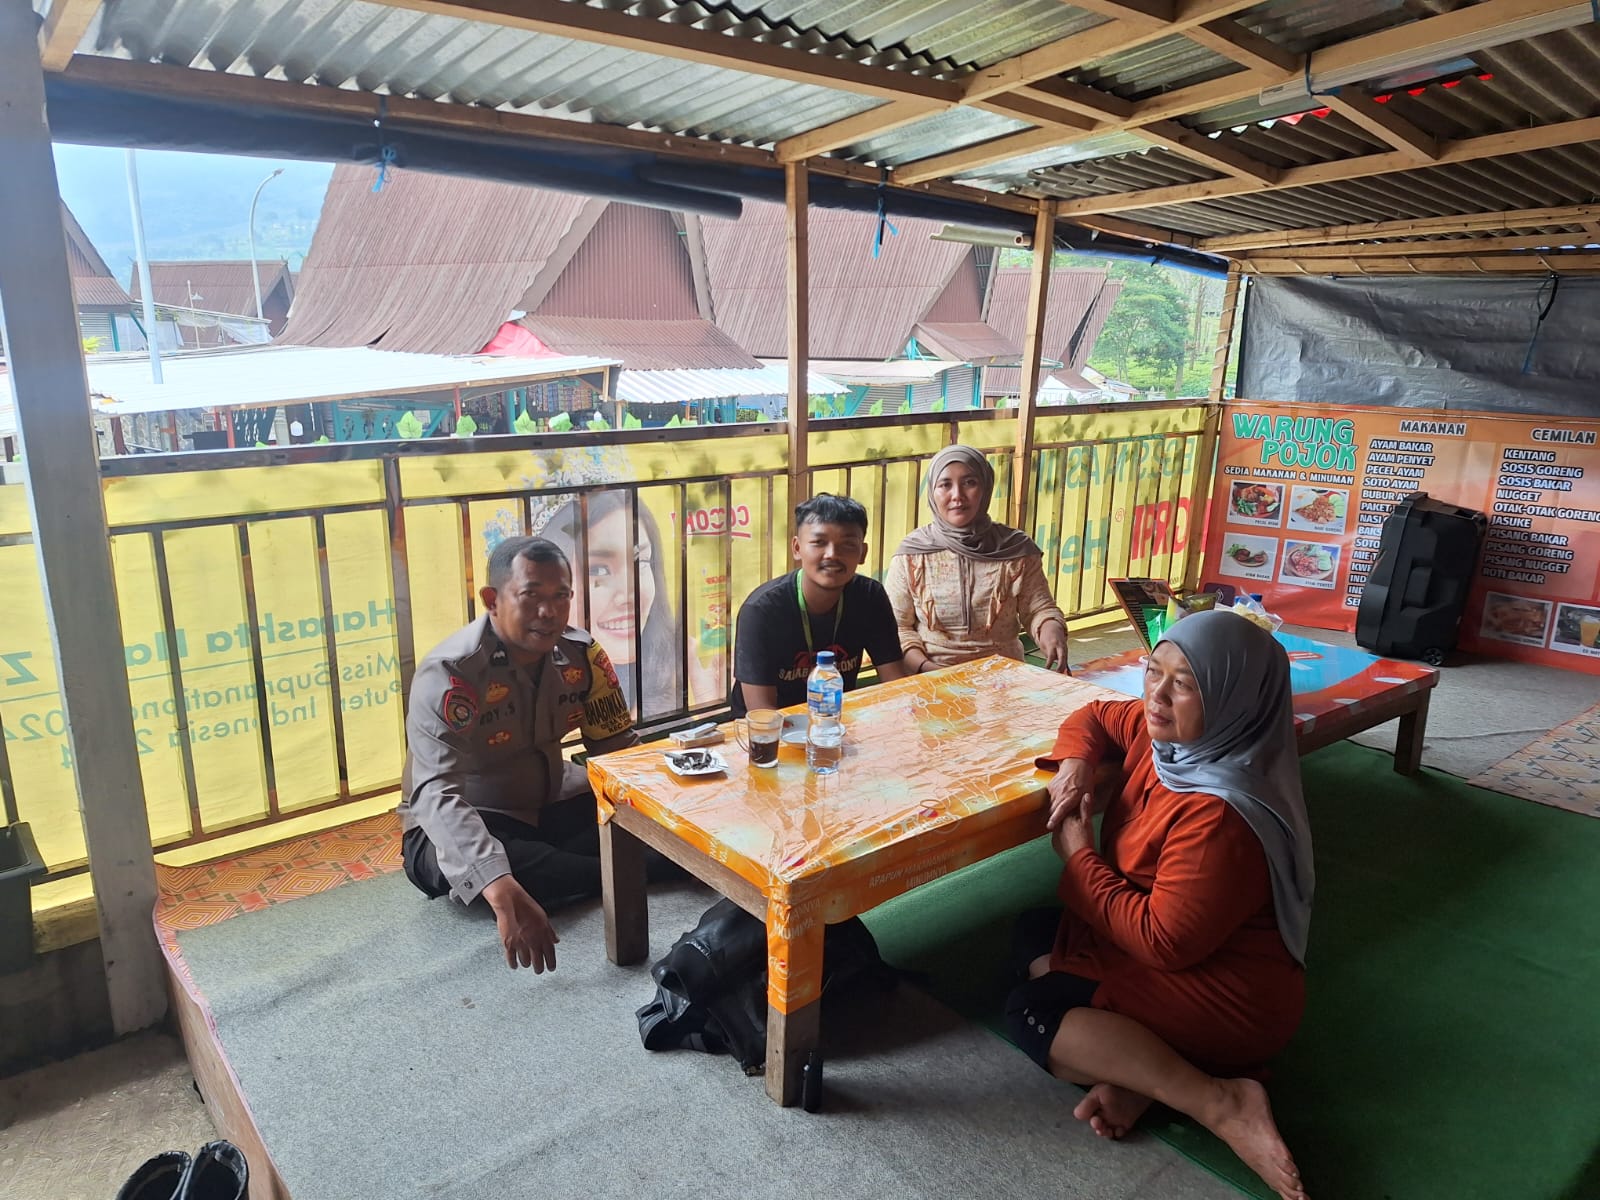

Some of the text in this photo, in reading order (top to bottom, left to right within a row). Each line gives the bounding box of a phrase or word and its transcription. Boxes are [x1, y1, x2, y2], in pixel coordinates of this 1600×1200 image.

[1232, 412, 1356, 445] WARUNG
[1400, 420, 1466, 437] MAKANAN
[1531, 427, 1597, 445] CEMILAN
[1370, 439, 1434, 453] AYAM BAKAR
[1260, 440, 1359, 471] POJOK
[1368, 452, 1436, 466] AYAM PENYET
[1504, 448, 1556, 462] KENTANG
[1224, 465, 1355, 485] SEDIA MAKANAN & MINUMAN
[1366, 464, 1425, 478] PECEL AYAM
[1501, 462, 1584, 478] SOSIS GORENG
[1363, 477, 1419, 490] SOTO AYAM
[1499, 475, 1572, 492] SOSIS BAKAR
[1362, 489, 1395, 501] BUBUR
[1496, 489, 1542, 502] NUGGET
[1360, 501, 1391, 512] PAKET
[1494, 502, 1557, 517] OTAK-OTAK
[1359, 514, 1382, 524] NASI
[1491, 515, 1532, 529] JASUKE
[1358, 526, 1383, 537] BAKS
[1489, 527, 1569, 547] PISANG BAKAR
[1355, 537, 1381, 549] SOTO
[1486, 541, 1575, 561] PISANG GORENG
[1485, 555, 1572, 574] PISANG NUGGET
[1350, 574, 1367, 583] IND
[1483, 567, 1546, 585] ROTI BAKAR
